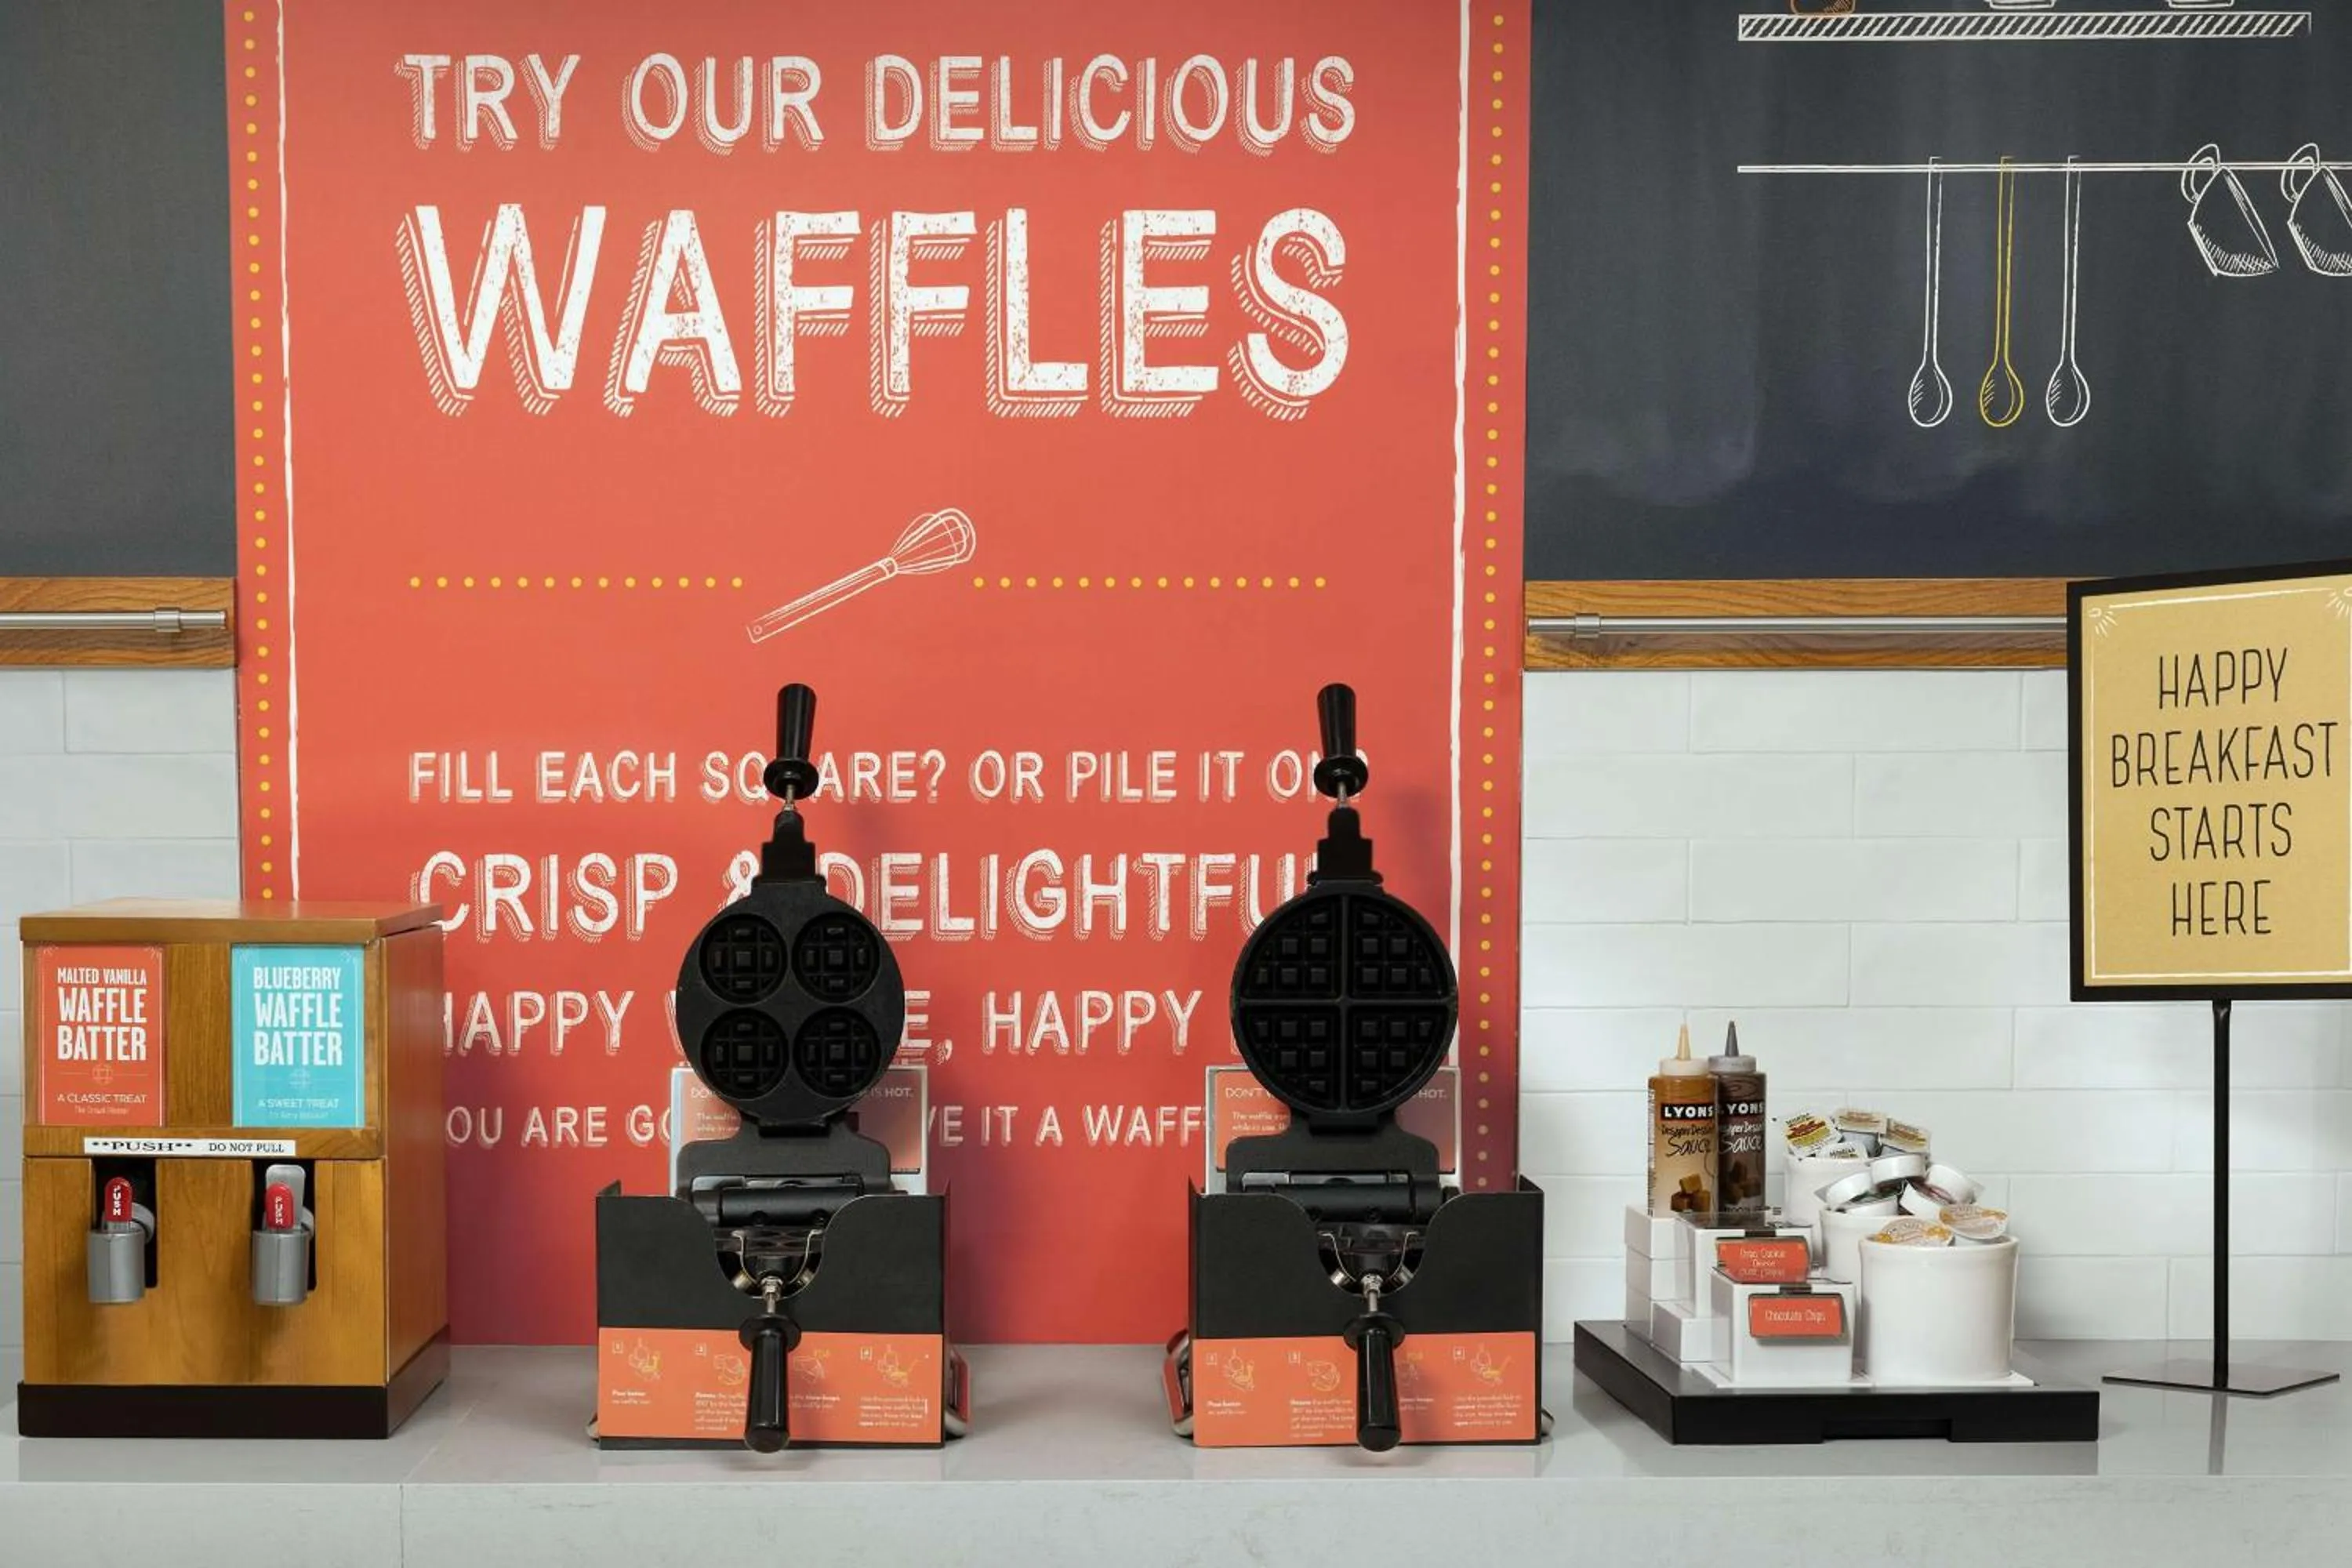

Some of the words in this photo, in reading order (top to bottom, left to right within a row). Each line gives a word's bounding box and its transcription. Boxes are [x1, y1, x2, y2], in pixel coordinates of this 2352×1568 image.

[394, 53, 580, 151] TRY
[622, 53, 824, 156] OUR
[865, 54, 1356, 157] DELICIOUS
[396, 203, 1348, 421] WAFFLES
[2158, 648, 2288, 709] HAPPY
[2112, 721, 2338, 788] BREAKFAST
[408, 750, 514, 803] FILL
[536, 750, 677, 804] EACH
[701, 749, 946, 804] SQARE?
[969, 750, 1044, 803] OR
[1066, 750, 1177, 803] PILE
[1198, 750, 1244, 803] IT
[2150, 802, 2292, 861] STARTS
[410, 851, 678, 944] CRISP
[816, 848, 1318, 943] DELIGHTFU
[2172, 880, 2272, 936] HERE
[57, 967, 100, 984] MALTED
[103, 968, 147, 985] VANILLA
[253, 967, 341, 989] BLUEBERRY
[58, 987, 147, 1023] WAFFLE
[254, 993, 343, 1028] WAFFLE
[982, 989, 1203, 1055] HAPPY
[57, 1025, 147, 1061] BATTER
[254, 1031, 343, 1065] BATTER
[67, 1094, 111, 1103] CLASSIC
[112, 1094, 147, 1104] TREAT
[1664, 1106, 1713, 1117] LYONS
[1726, 1102, 1763, 1114] YONS
[445, 1105, 503, 1149] OU
[521, 1106, 608, 1147] ARE
[981, 1105, 1018, 1147] IT
[1035, 1105, 1063, 1147] A
[1082, 1104, 1203, 1147] WAFF
[209, 1142, 227, 1152] DO
[229, 1143, 253, 1152] NOT
[256, 1143, 285, 1152] PULL
